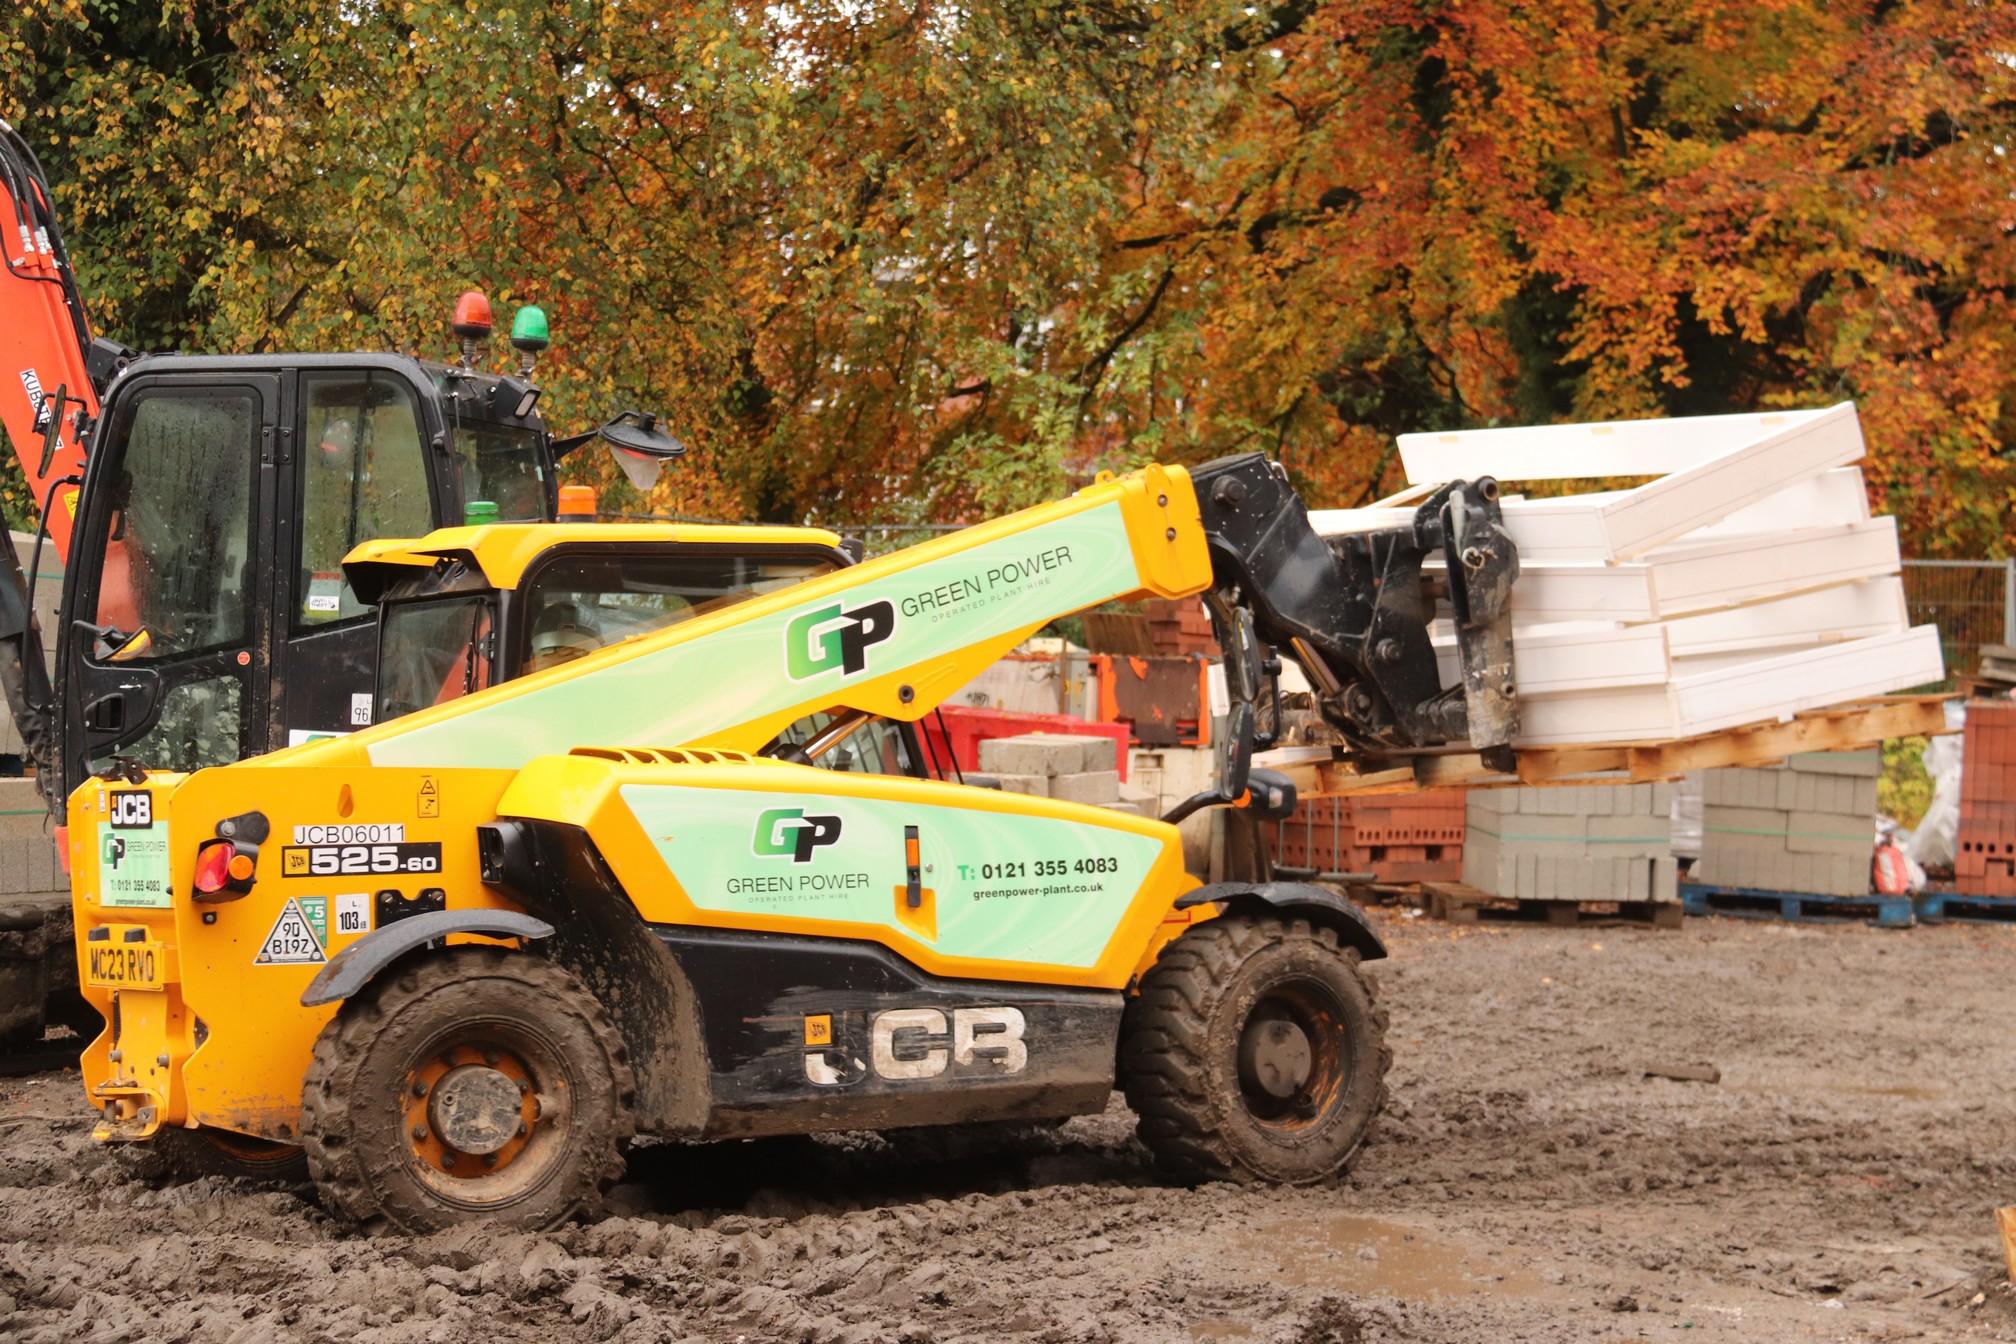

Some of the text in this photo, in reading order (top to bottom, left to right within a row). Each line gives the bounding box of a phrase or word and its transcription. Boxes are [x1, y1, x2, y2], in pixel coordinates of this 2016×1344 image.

[901, 546, 1072, 617] GREEN POWER
[931, 577, 1051, 623] OPERATED PLANT HIRE
[786, 600, 895, 681] GP
[354, 707, 369, 722] 96
[111, 794, 151, 825] JCB
[295, 825, 405, 845] JCB06011
[752, 808, 842, 863] GP
[127, 841, 167, 852] GREEN POWER
[957, 857, 1118, 881] T: 0121 355 4083
[118, 879, 132, 891] 0121
[133, 879, 144, 892] 355
[146, 880, 160, 892] 4083
[726, 873, 870, 894] GREEN POWER
[973, 882, 1104, 901] greenpower-plant.co.uk
[748, 896, 794, 904] OPERATED
[339, 911, 359, 931] 103
[90, 948, 124, 981] MC23
